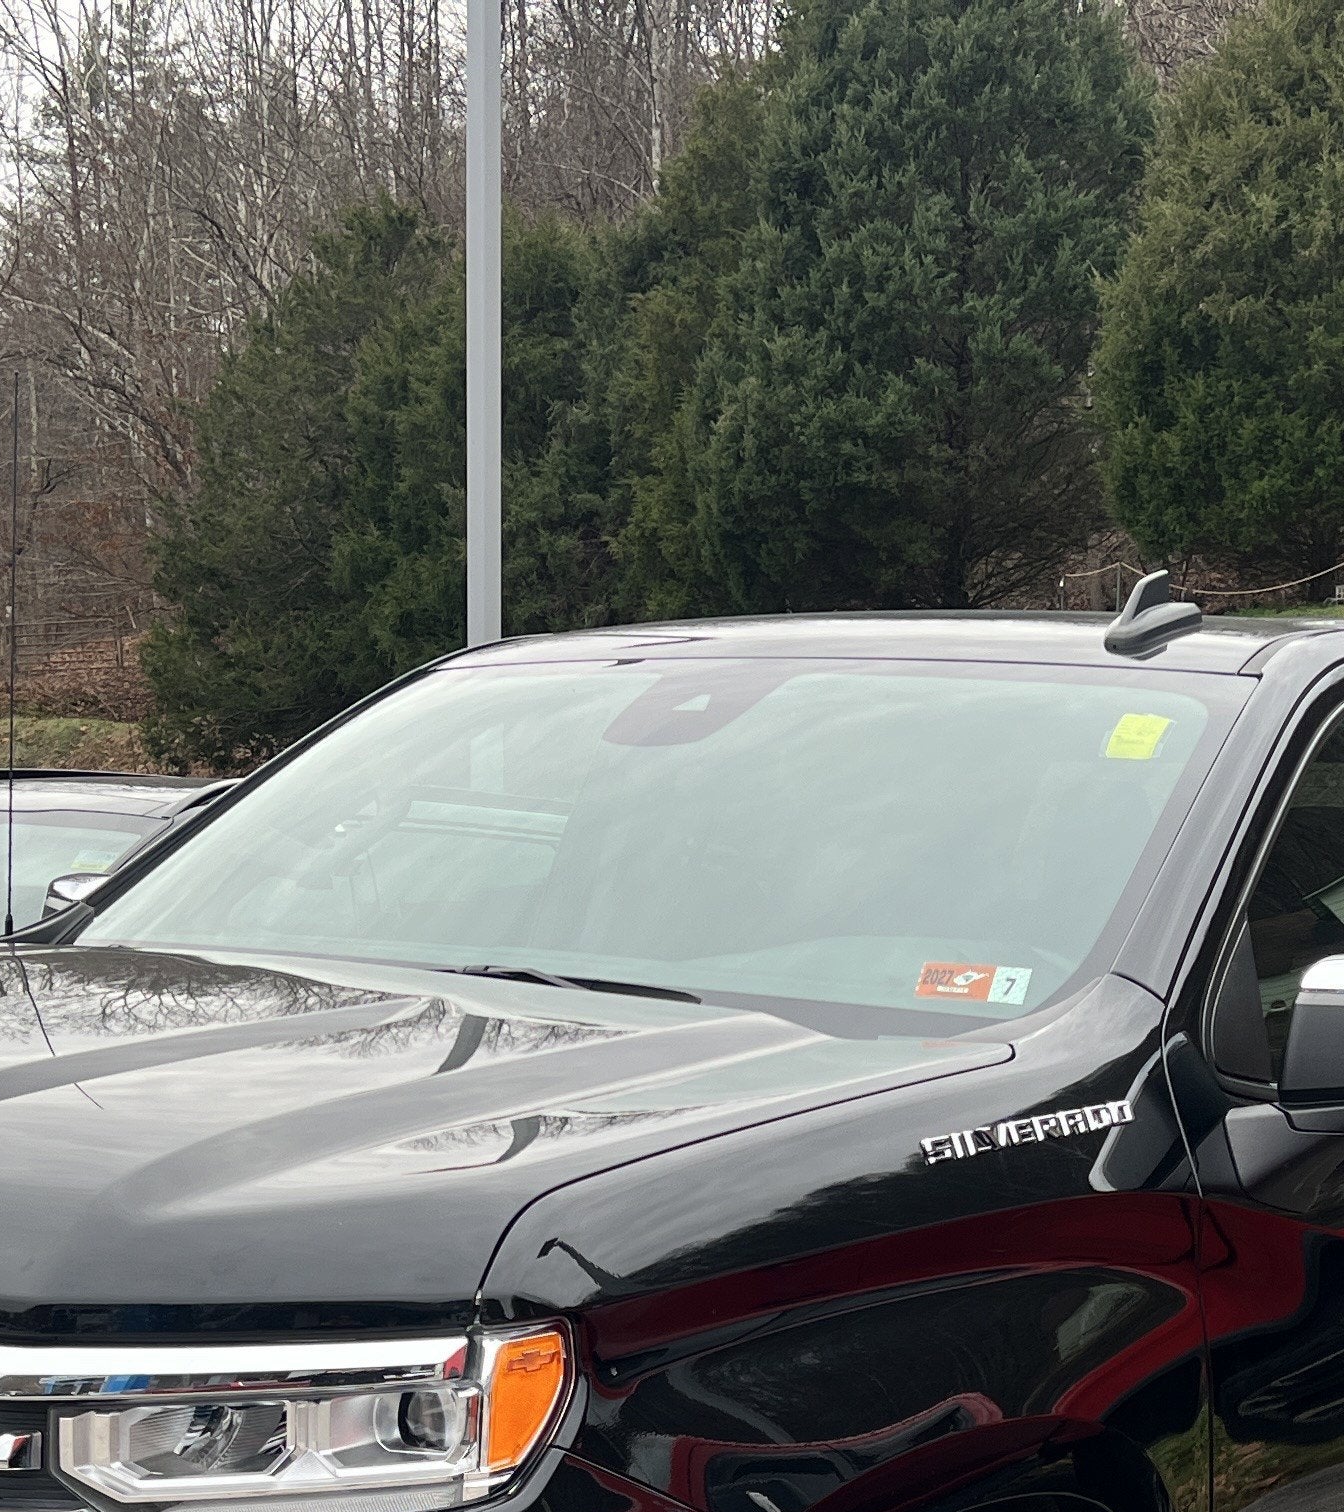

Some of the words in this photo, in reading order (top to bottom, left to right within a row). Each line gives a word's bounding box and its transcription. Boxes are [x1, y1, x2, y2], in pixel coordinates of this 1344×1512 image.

[922, 968, 955, 986] 2027
[1003, 976, 1017, 996] 7
[919, 1099, 1135, 1166] SILVERADO
